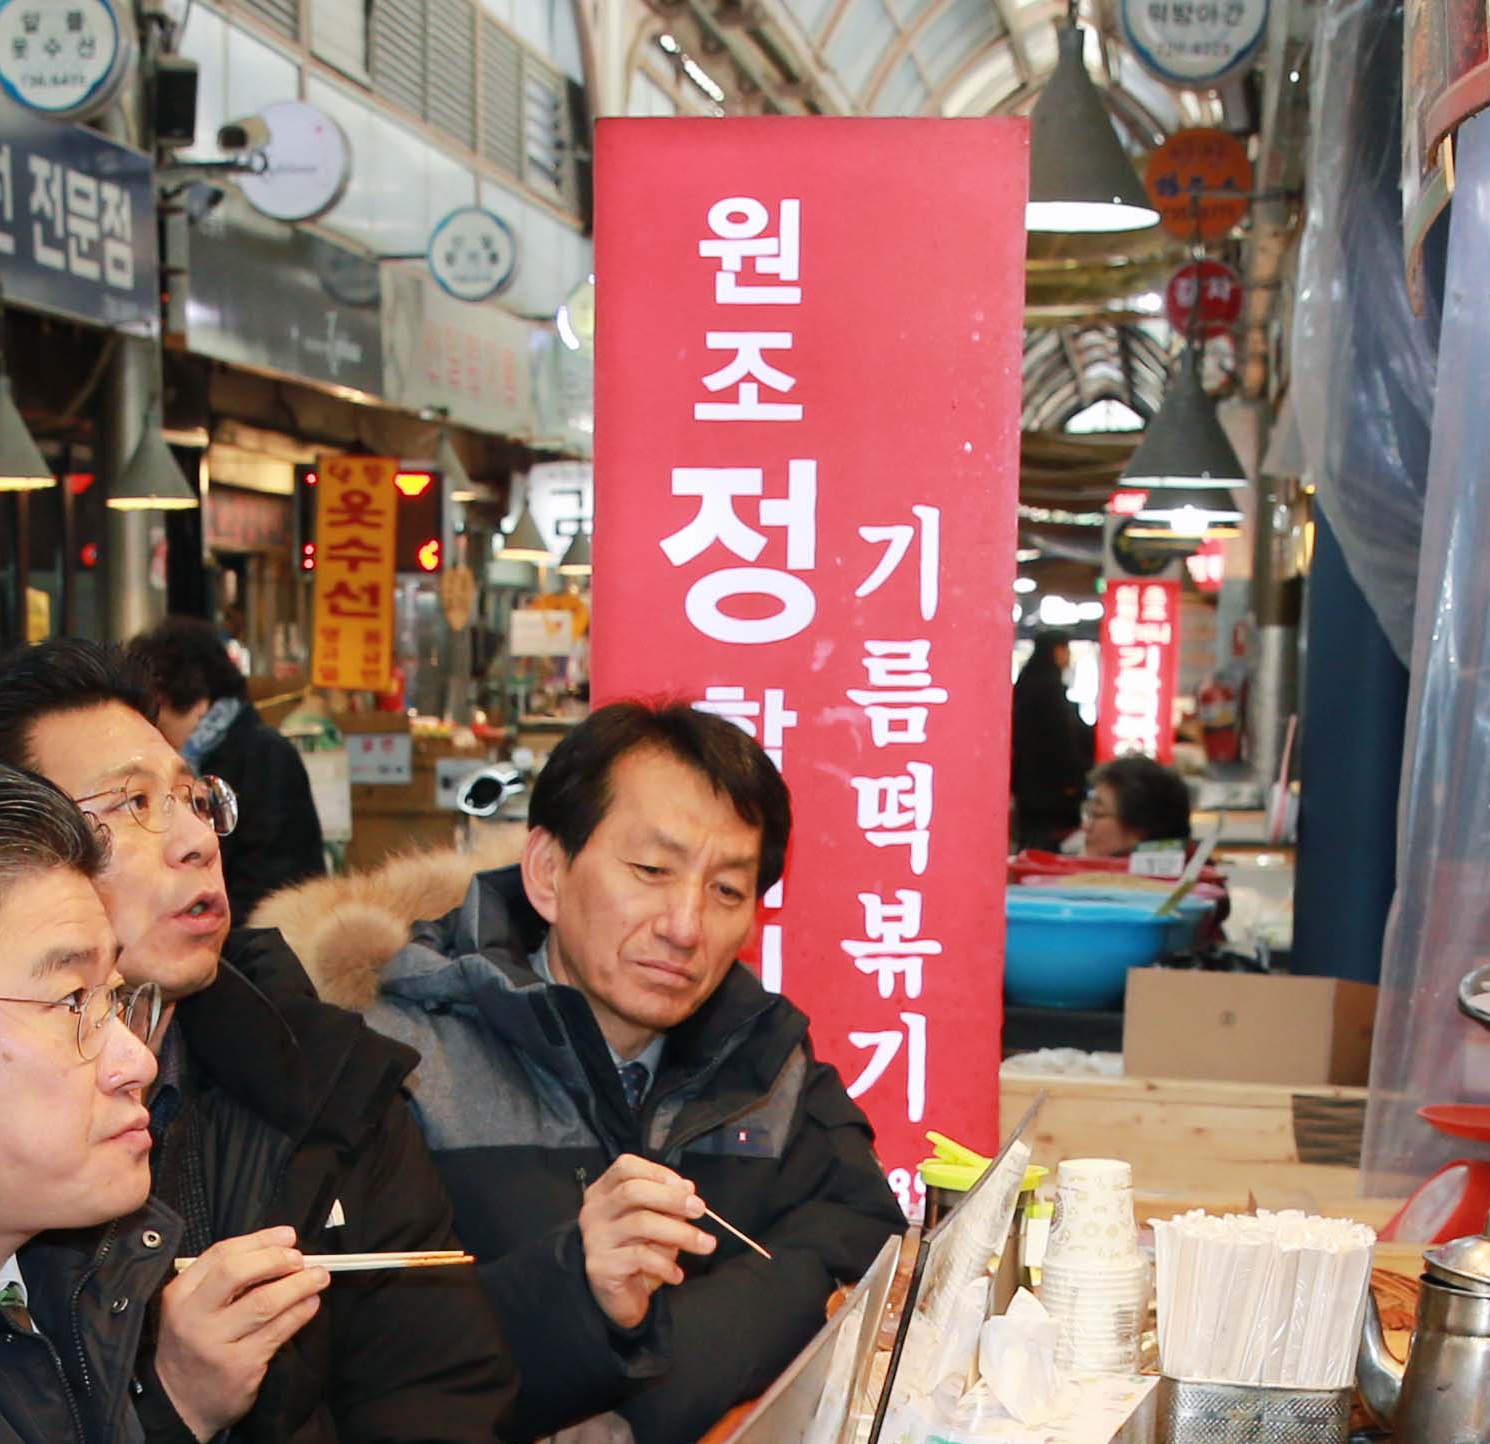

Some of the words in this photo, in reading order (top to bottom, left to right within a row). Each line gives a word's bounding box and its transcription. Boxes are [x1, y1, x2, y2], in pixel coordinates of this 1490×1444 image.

[27, 154, 135, 291] 전문점
[694, 196, 803, 421] 원조
[322, 489, 386, 620] 옷수선
[841, 504, 949, 1122] 기름떡볶기
